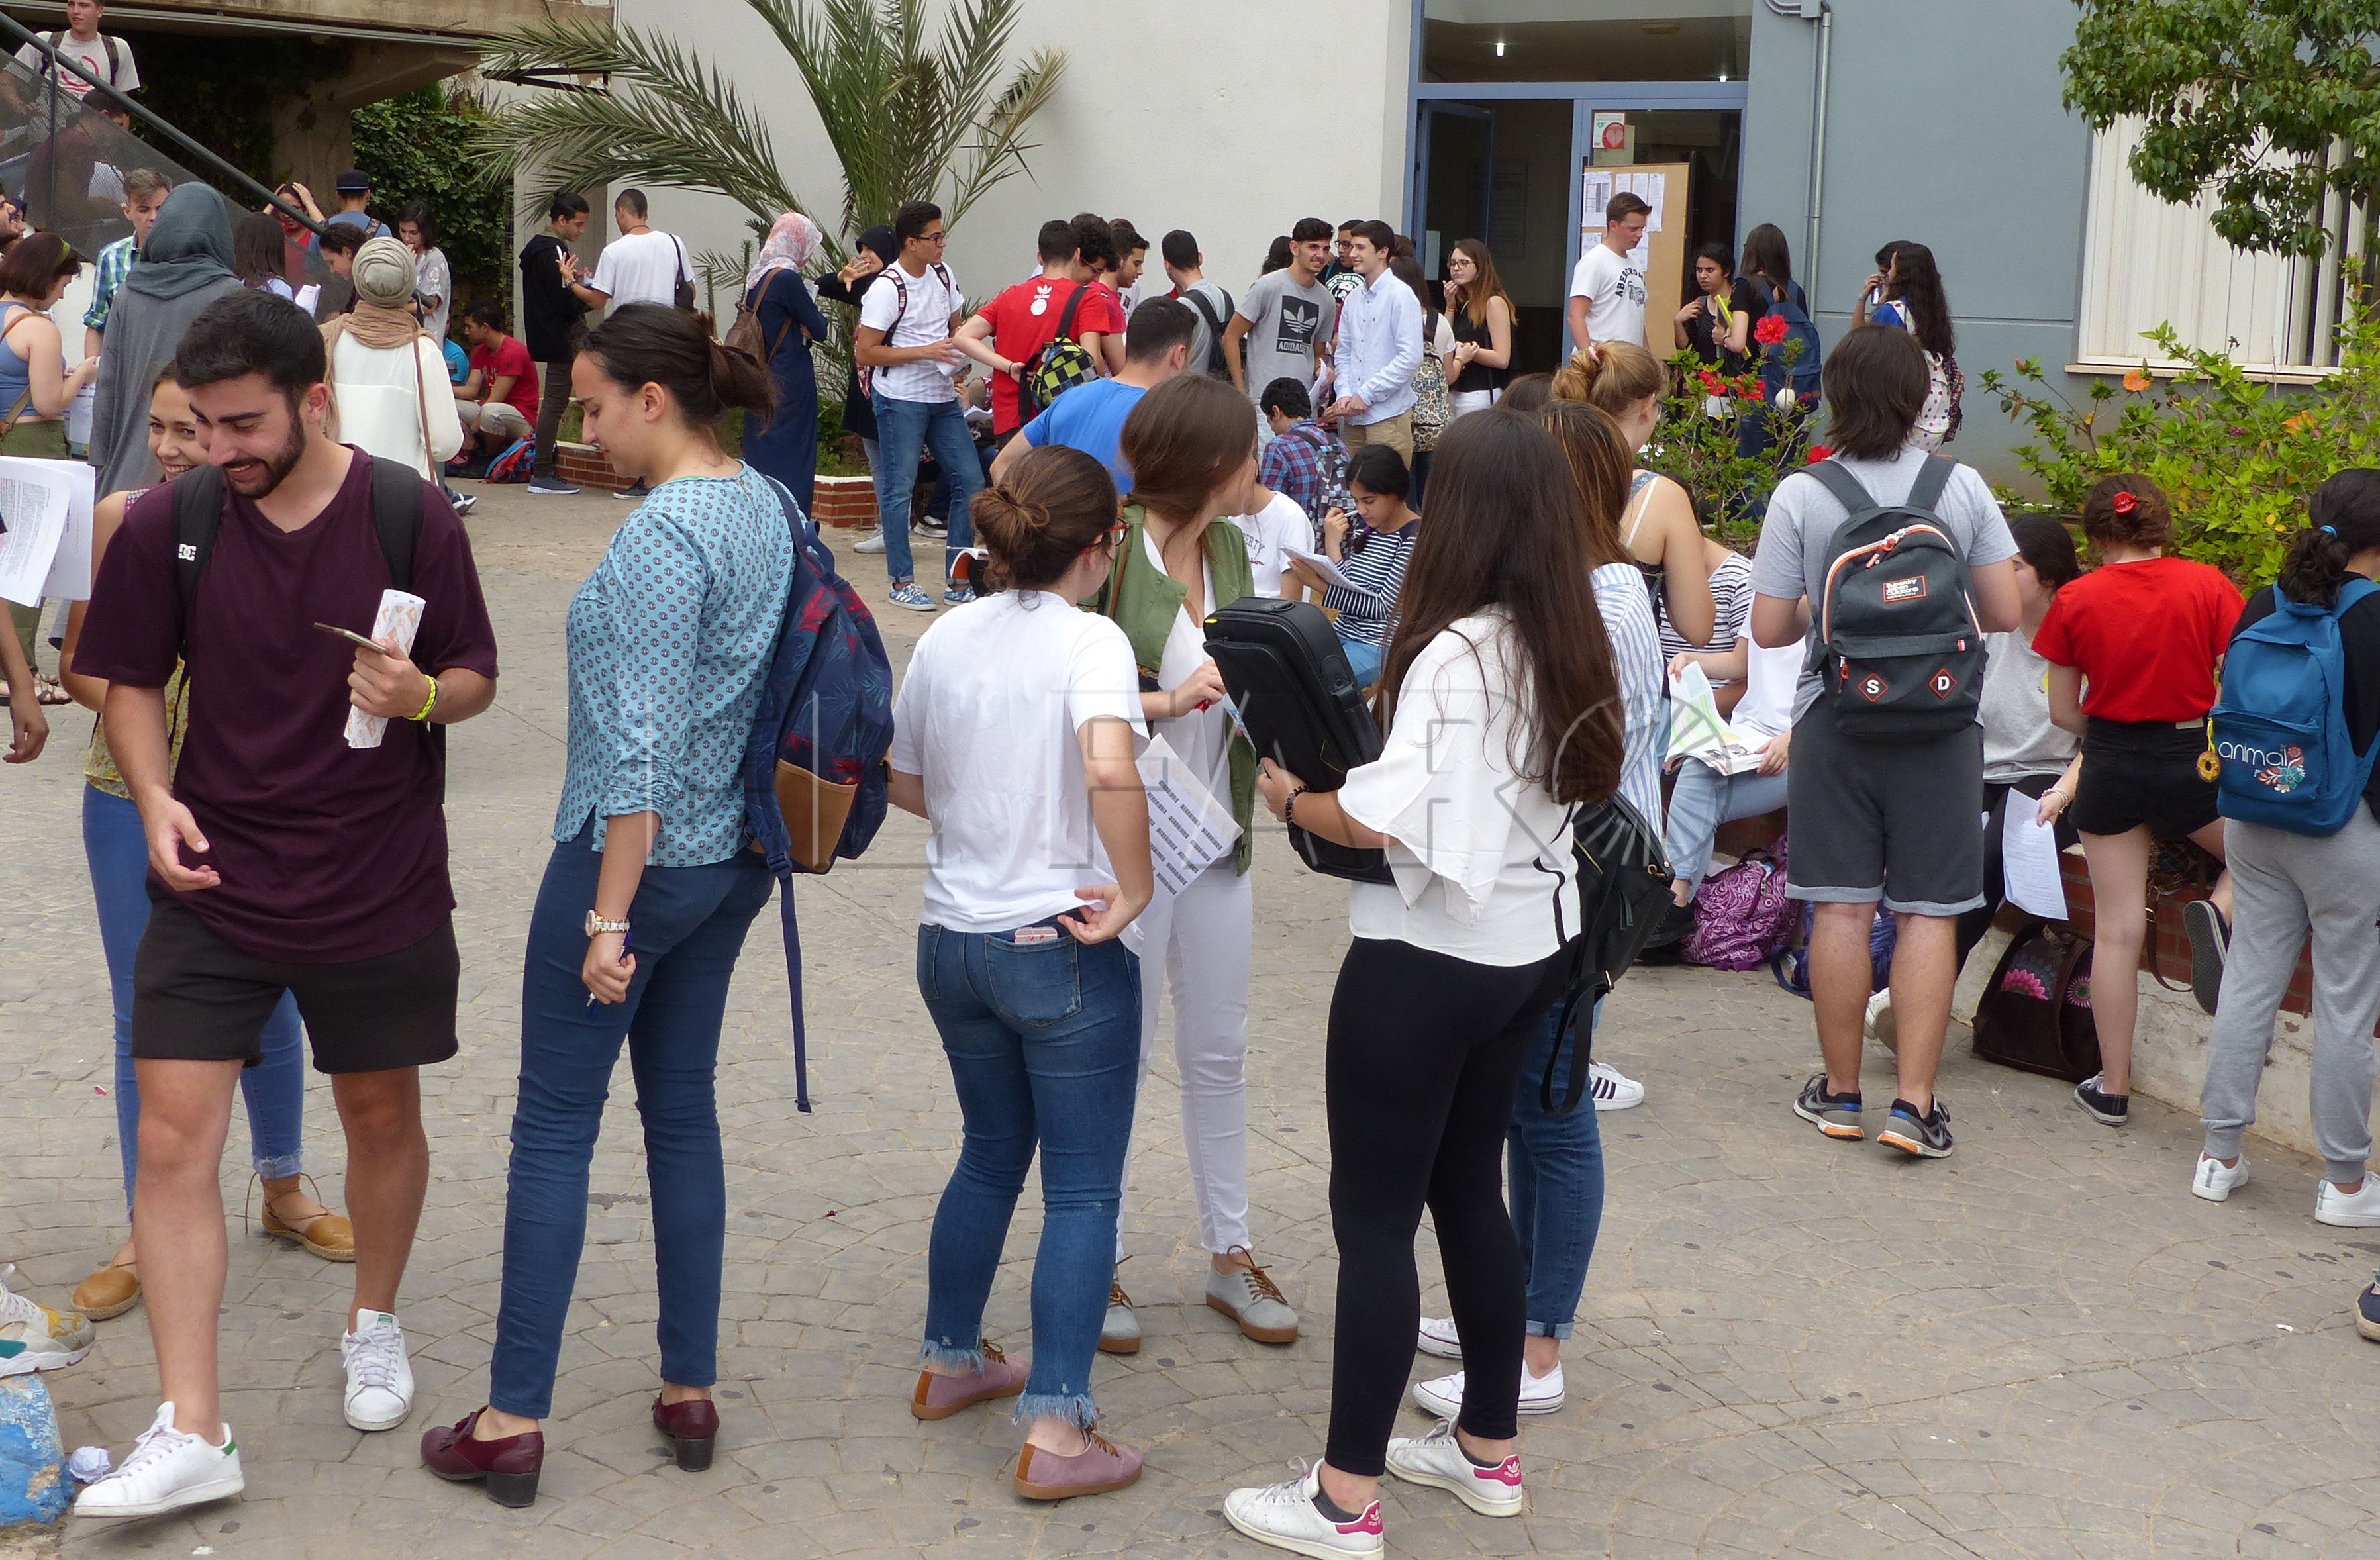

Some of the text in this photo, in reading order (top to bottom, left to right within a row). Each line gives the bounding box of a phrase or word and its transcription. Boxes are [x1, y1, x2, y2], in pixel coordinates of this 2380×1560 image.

[1867, 679, 1879, 694] S
[1938, 676, 1950, 691] D
[2218, 740, 2287, 767] animal
